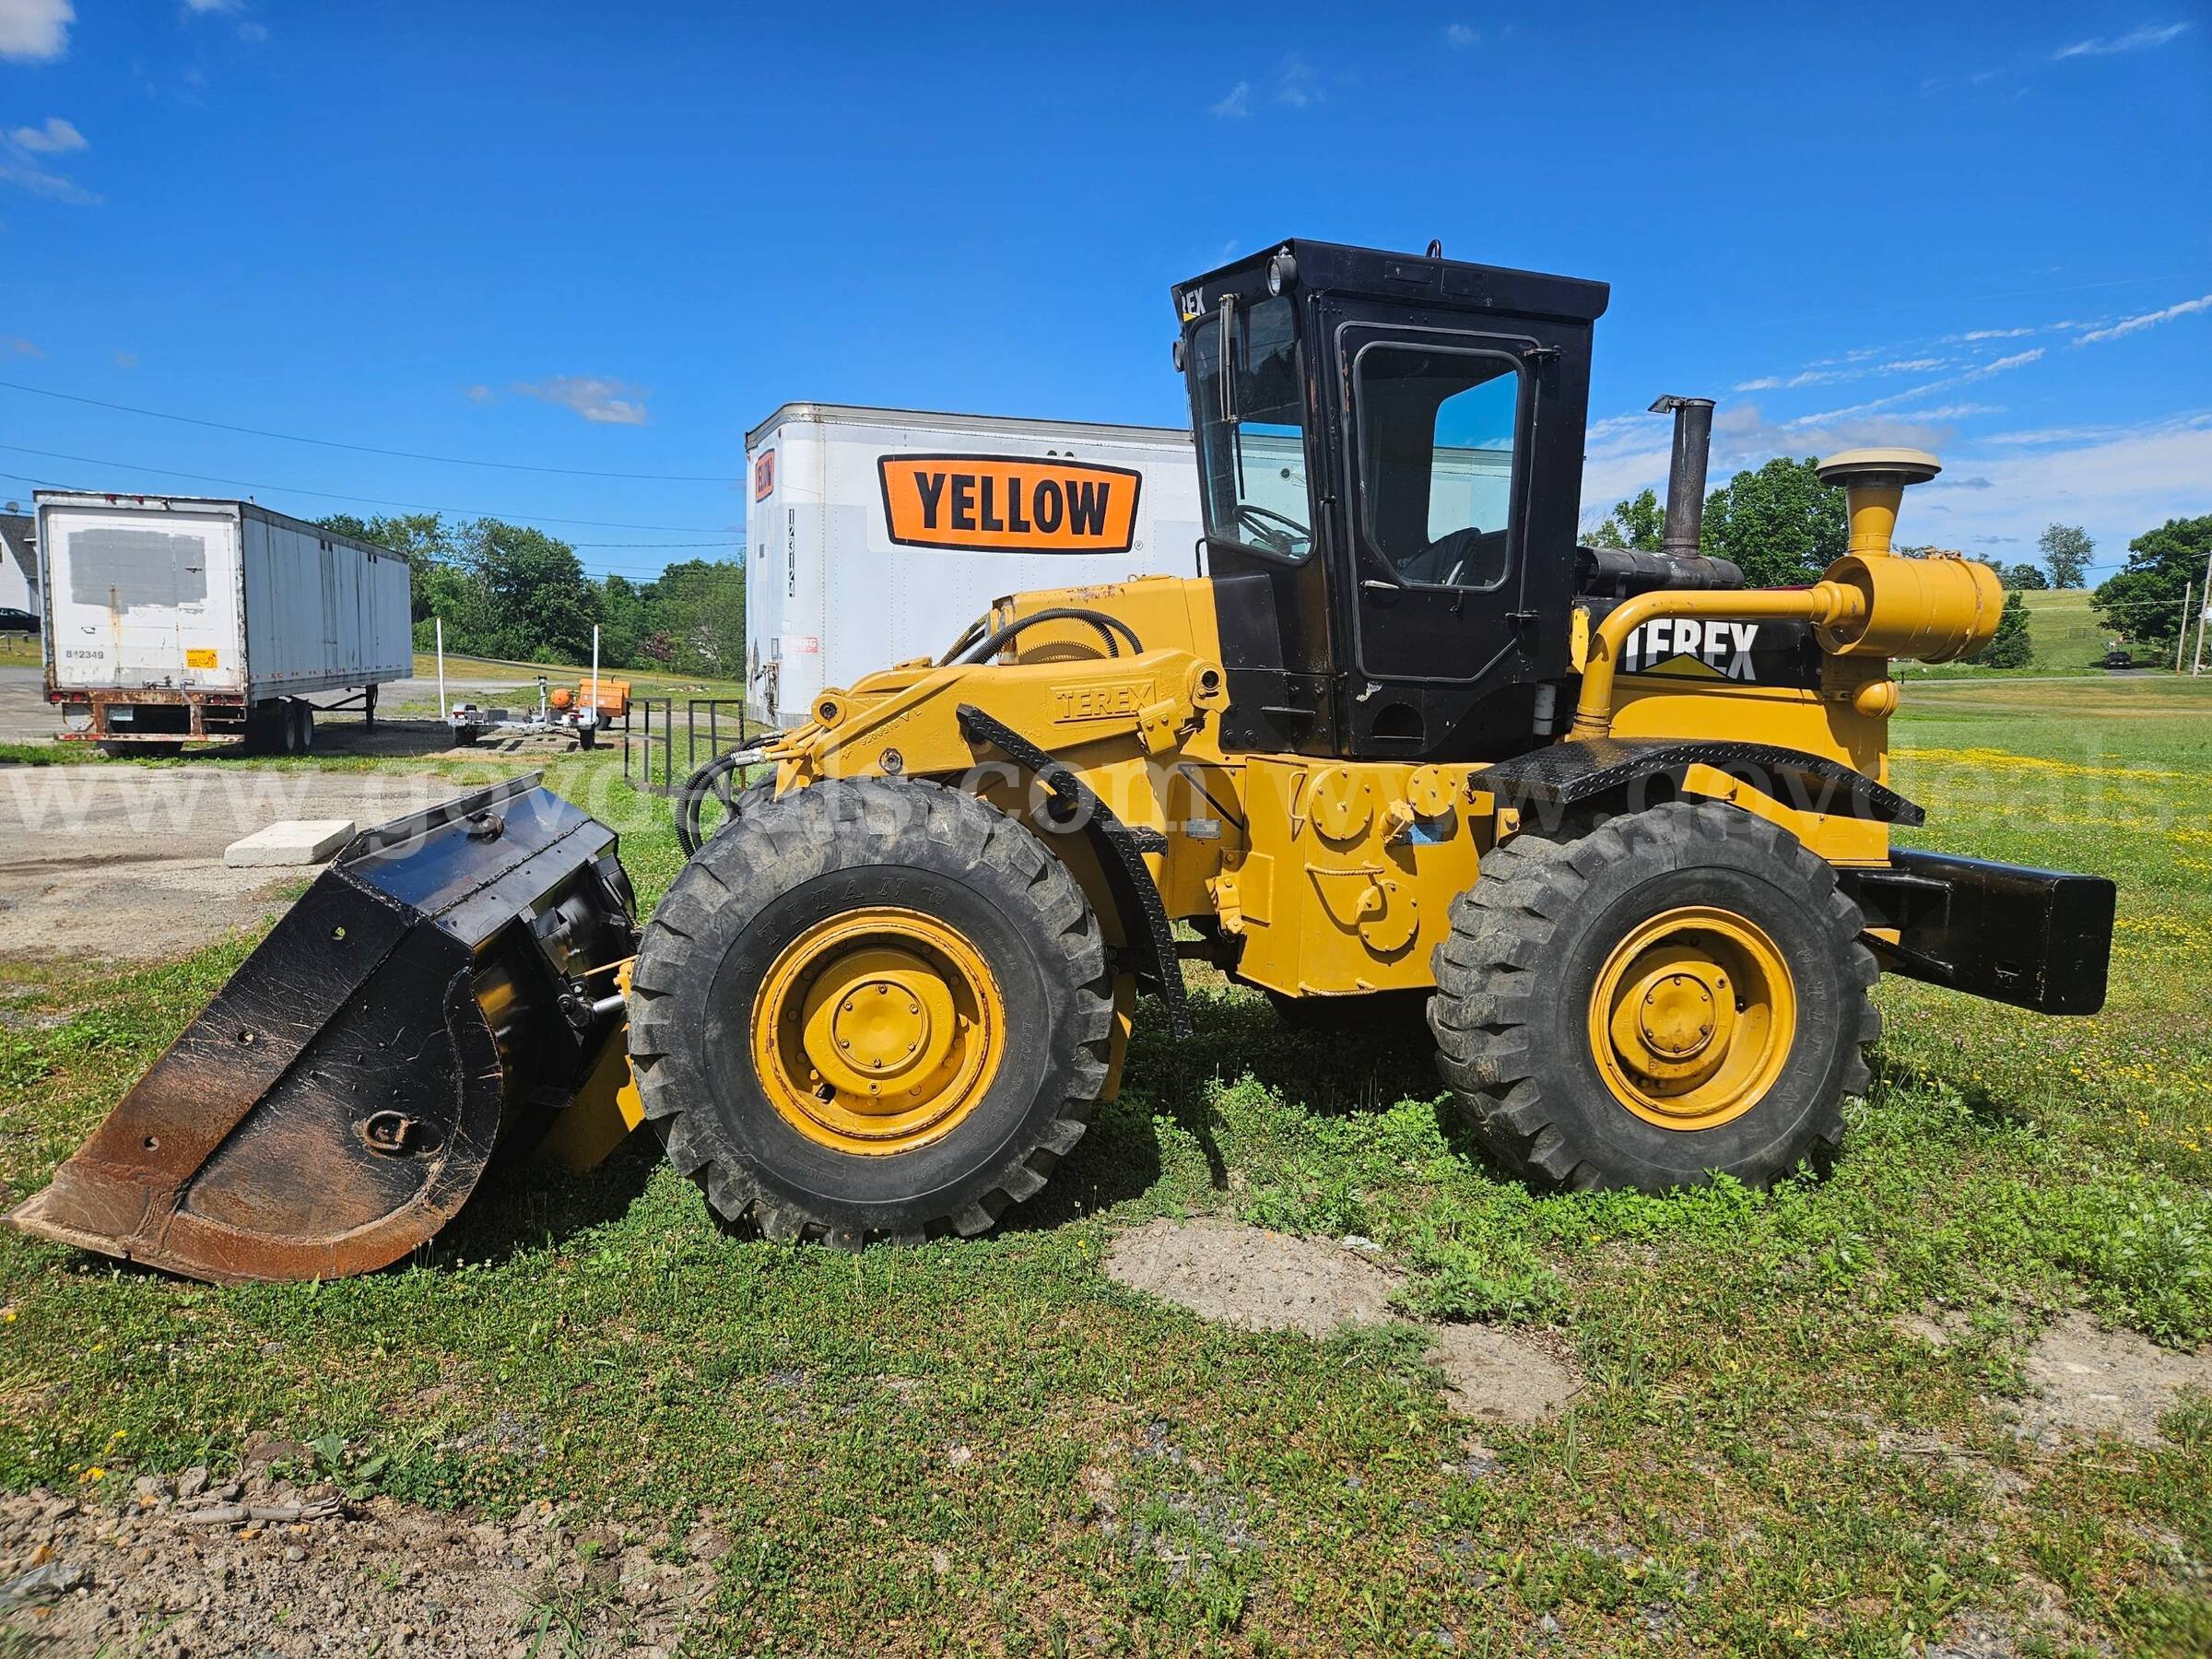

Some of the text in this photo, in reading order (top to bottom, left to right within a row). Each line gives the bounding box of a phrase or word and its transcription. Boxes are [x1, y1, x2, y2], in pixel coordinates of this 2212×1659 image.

[913, 471, 1111, 536] YELLOW
[1625, 618, 1759, 681] TEREX
[1055, 684, 1152, 720] TEREX
[757, 877, 908, 947] TITAN
